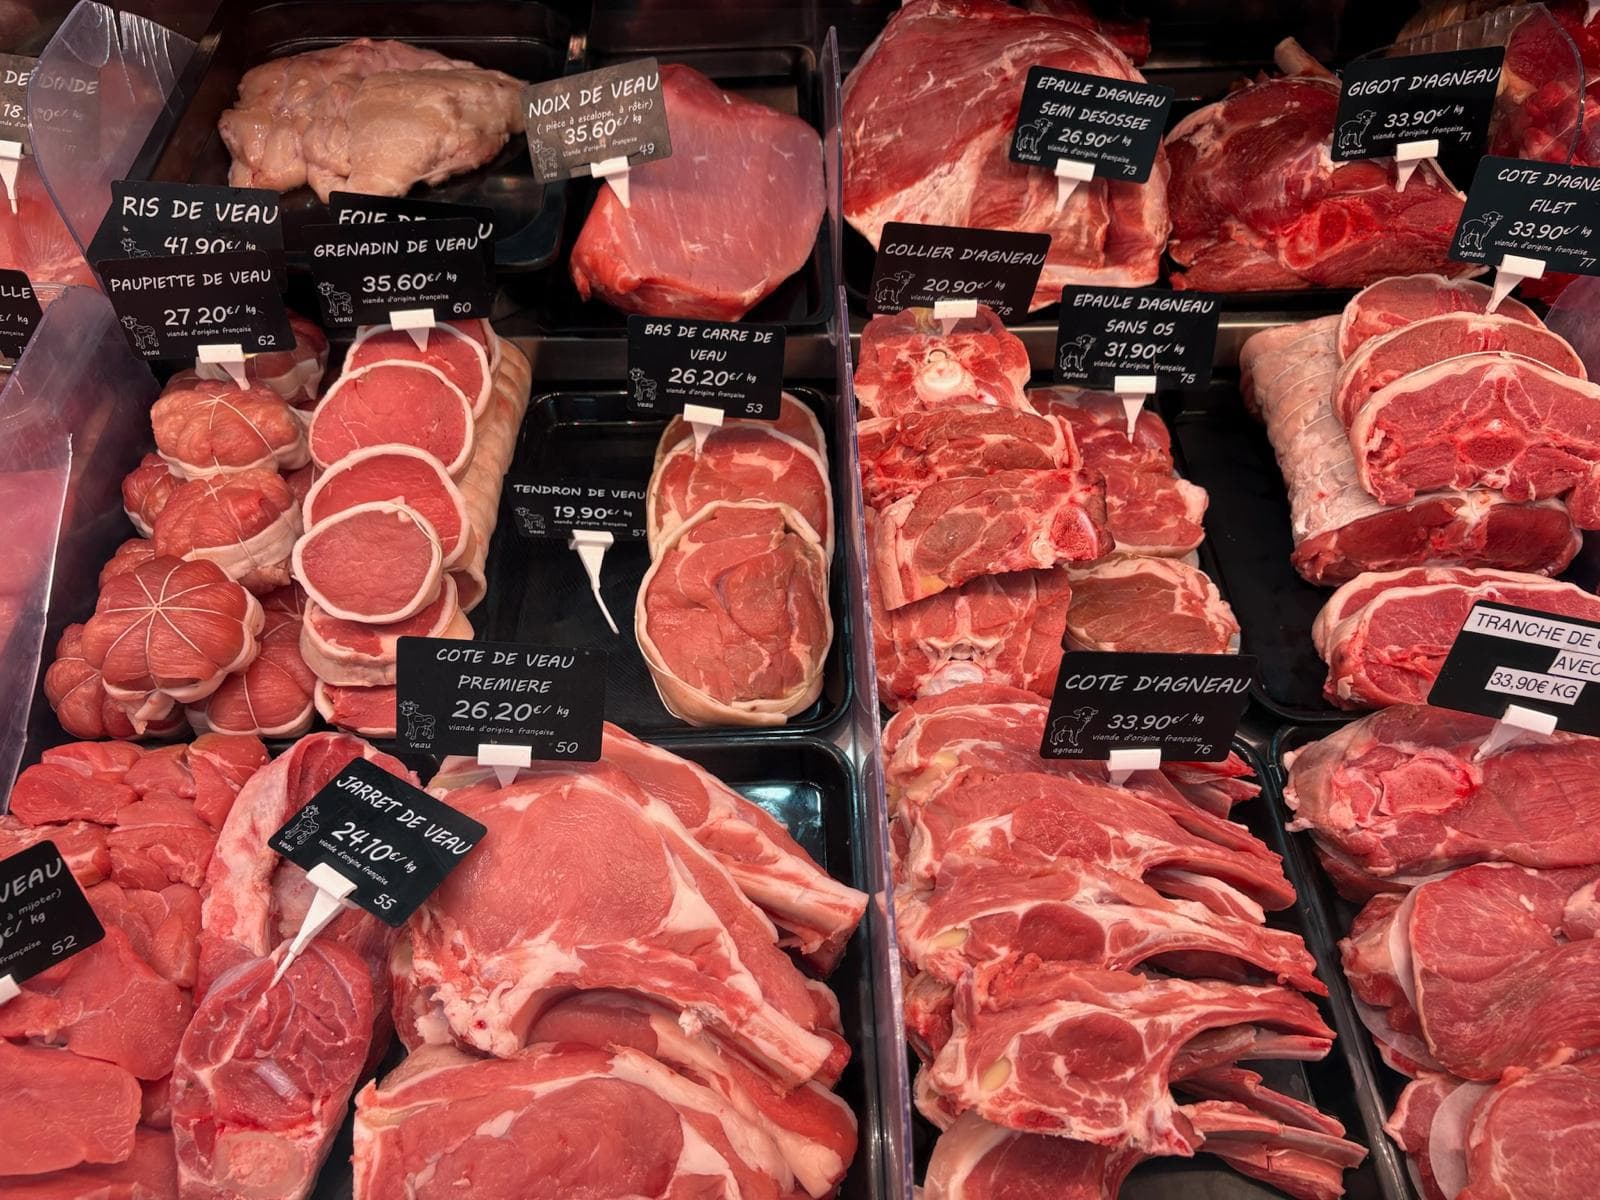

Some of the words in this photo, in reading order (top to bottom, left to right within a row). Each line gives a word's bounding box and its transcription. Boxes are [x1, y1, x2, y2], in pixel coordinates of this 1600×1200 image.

[4, 70, 30, 86] DE
[1348, 77, 1405, 96] GIGOT
[1408, 67, 1500, 91] D'AGNEAU
[529, 92, 570, 118] NOIX
[580, 86, 602, 106] DE
[611, 72, 658, 98] VEAU
[1037, 77, 1093, 96] EPAULE
[1096, 86, 1166, 108] DAGNEAU
[1454, 104, 1464, 114] kg
[546, 121, 565, 132] pièce
[570, 117, 574, 125] à
[628, 99, 653, 112] rôtir)
[633, 114, 642, 124] kg
[1040, 102, 1076, 118] SEMI
[1079, 109, 1150, 131] DESOSSEE
[1373, 132, 1395, 140] viande
[1399, 128, 1428, 138] d'origine
[1432, 125, 1463, 134] française
[1459, 132, 1471, 142] 71
[1122, 137, 1132, 146] kg
[640, 144, 654, 154] 49
[1048, 145, 1068, 153] viande
[1071, 148, 1098, 158] d'origine
[1101, 153, 1129, 163] française
[1341, 149, 1366, 157] agneau
[1018, 153, 1041, 161] agneau
[1122, 165, 1137, 175] 73
[1498, 169, 1541, 184] COTE
[122, 196, 159, 217] RIS
[171, 200, 203, 219] DE
[216, 203, 278, 224] VEAU
[1529, 199, 1577, 214] FILET
[1581, 226, 1592, 237] kg
[246, 241, 256, 250] kg
[314, 240, 398, 257] GRENADIN
[407, 239, 428, 253] DE
[436, 236, 478, 251] VEAU
[1495, 240, 1518, 248] viande
[1521, 242, 1551, 252] d'origine
[1555, 246, 1588, 256] française
[885, 244, 954, 259] COLLIER
[960, 249, 1046, 265] D'AGNEAU
[1579, 258, 1596, 267] 77
[111, 274, 195, 291] PAUPIETTE
[203, 273, 223, 286] DE
[230, 269, 271, 284] VEAU
[447, 272, 457, 282] kg
[995, 281, 1006, 290] kg
[362, 295, 384, 303] viande
[388, 295, 416, 303] d'origine
[420, 292, 448, 301] française
[1073, 293, 1133, 309] EPAULE
[1137, 298, 1214, 313] DAGNEAU
[246, 305, 256, 315] kg
[453, 302, 471, 313] 60
[998, 307, 1013, 316] 78
[17, 315, 28, 324] kg
[166, 328, 188, 337] viande
[191, 327, 218, 336] d'origine
[223, 326, 251, 334] française
[645, 324, 672, 336] BAS
[678, 326, 697, 338] DE
[702, 328, 749, 341] CARRE
[753, 332, 773, 343] DE
[1105, 319, 1148, 335] SANS
[1153, 322, 1175, 336] OS
[258, 335, 276, 346] 62
[690, 349, 727, 361] VEAU
[1174, 344, 1185, 355] kg
[1120, 360, 1150, 370] d'origine
[1154, 363, 1186, 373] française
[747, 373, 757, 383] kg
[1180, 373, 1196, 384] 75
[689, 388, 714, 397] d'origine
[718, 390, 745, 399] française
[746, 403, 763, 413] 53
[514, 484, 581, 496] TENDRON
[612, 490, 646, 499] VEAU
[1477, 613, 1565, 641] TRANCHE
[1568, 631, 1595, 647] DE
[436, 649, 485, 664] COTE
[492, 652, 518, 665] DE
[527, 654, 574, 668] VEAU
[458, 675, 552, 693] PREMIERE
[1065, 675, 1128, 692] COTE
[1133, 675, 1252, 694] D'AGNEAU
[1491, 673, 1549, 693] 33,90€
[1551, 683, 1578, 698] KG
[557, 706, 569, 718] kg
[1192, 713, 1204, 724] kg
[479, 725, 513, 735] d'origine
[519, 727, 554, 736] française
[1093, 733, 1119, 741] viande
[1124, 734, 1160, 743] d'origine
[1165, 734, 1202, 743] française
[556, 742, 579, 753] 50
[1053, 746, 1083, 754] agneau
[1194, 744, 1212, 755] 76
[337, 775, 403, 813] JARRET
[397, 810, 427, 829] DE
[424, 824, 472, 855] VEAU
[278, 840, 294, 852] veau
[319, 839, 337, 853] viande
[337, 850, 361, 869] d'origine
[363, 866, 388, 885] française
[404, 860, 417, 874] kg
[7, 912, 13, 920] à
[19, 888, 61, 915] mijoter)
[374, 893, 397, 910] 55
[31, 912, 45, 924] kg
[52, 935, 77, 955] 52
